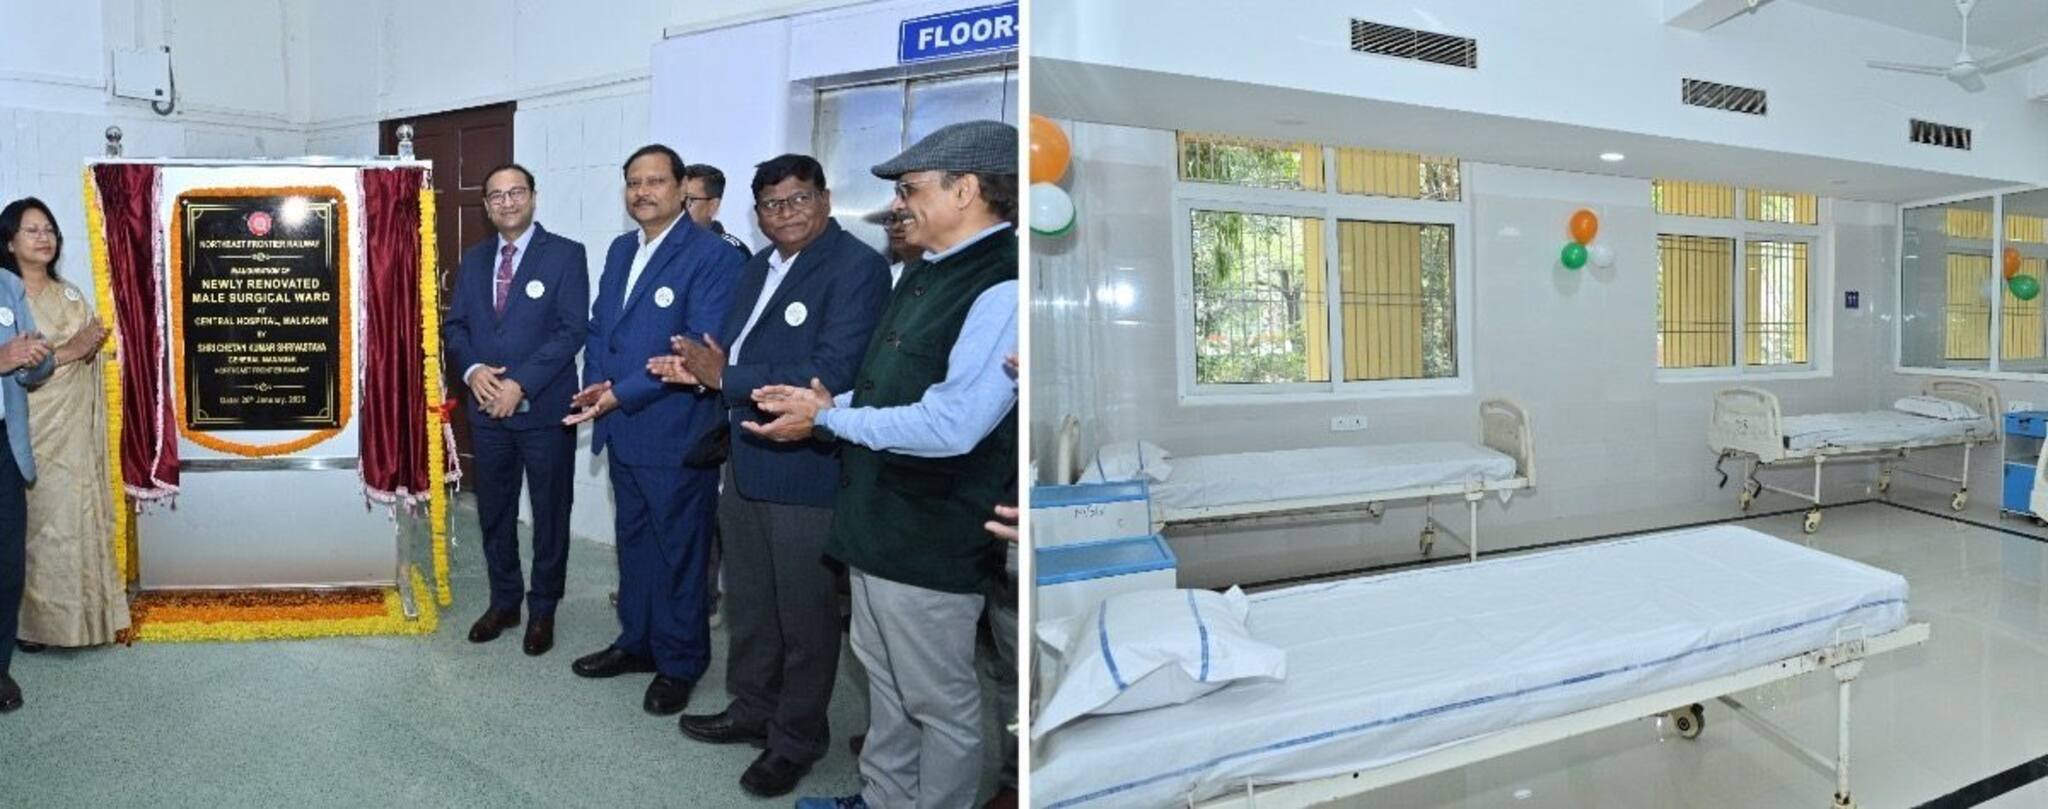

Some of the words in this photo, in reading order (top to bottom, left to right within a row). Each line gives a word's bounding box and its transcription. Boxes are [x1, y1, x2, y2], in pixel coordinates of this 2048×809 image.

[202, 279, 244, 289] NEWLY
[247, 278, 320, 289] RENOVATED
[192, 293, 225, 303] MALE
[229, 293, 291, 303] SURGICAL
[295, 292, 330, 302] WARD
[194, 317, 235, 326] CENTRAL
[236, 317, 281, 327] HOSPITAL,
[283, 316, 329, 325] MALIGAON
[257, 330, 267, 338] BY
[249, 343, 275, 352] KUMAR
